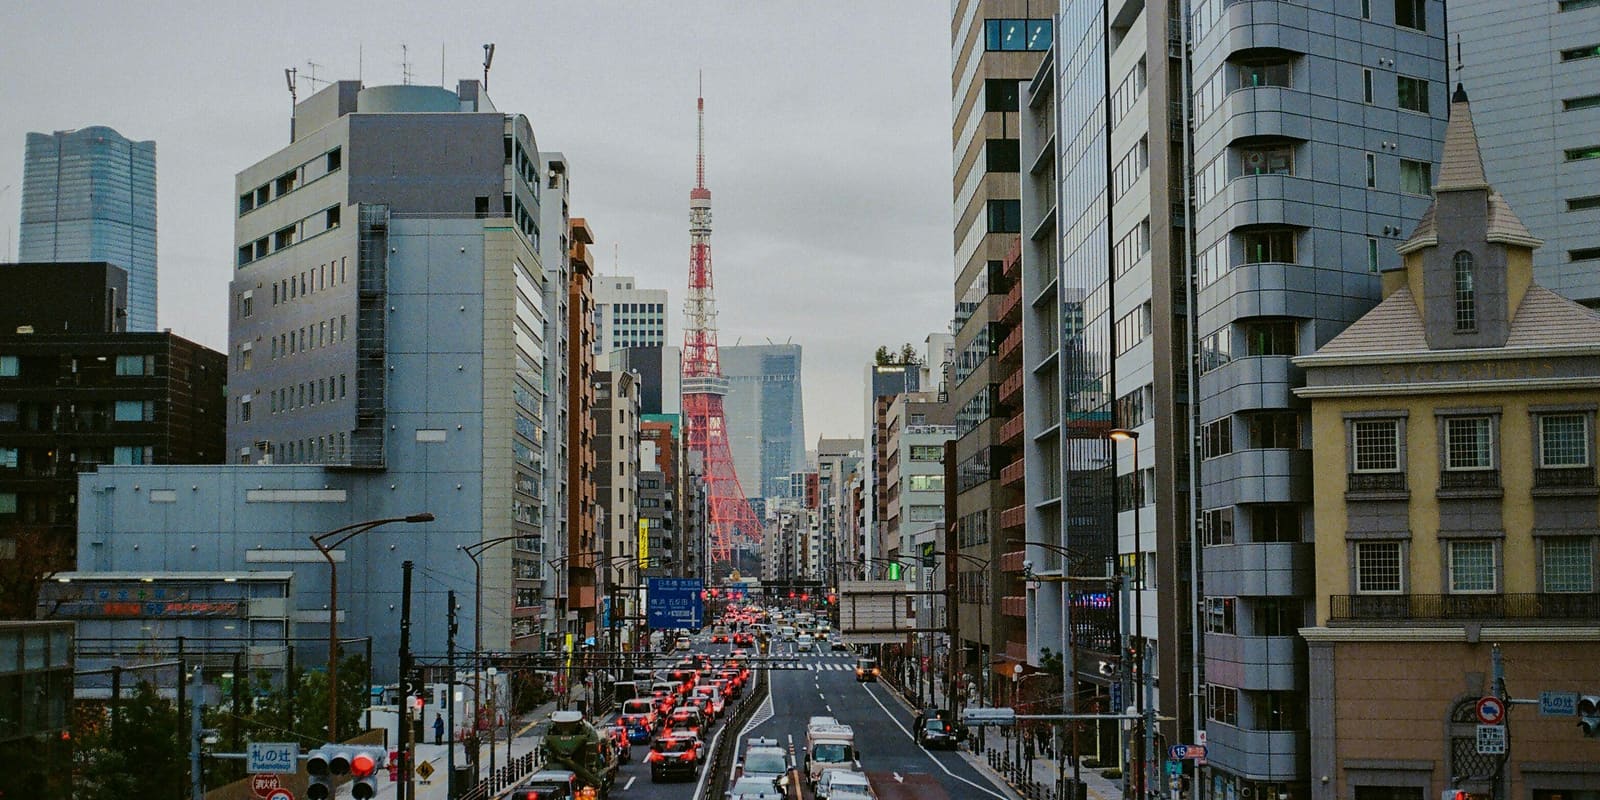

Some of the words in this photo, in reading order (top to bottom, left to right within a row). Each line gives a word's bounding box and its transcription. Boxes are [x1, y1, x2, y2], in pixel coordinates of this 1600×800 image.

[1542, 693, 1573, 707] 札の辻
[252, 748, 291, 762] 札の辻
[1176, 747, 1185, 756] 15
[256, 778, 278, 789] 消火栓
